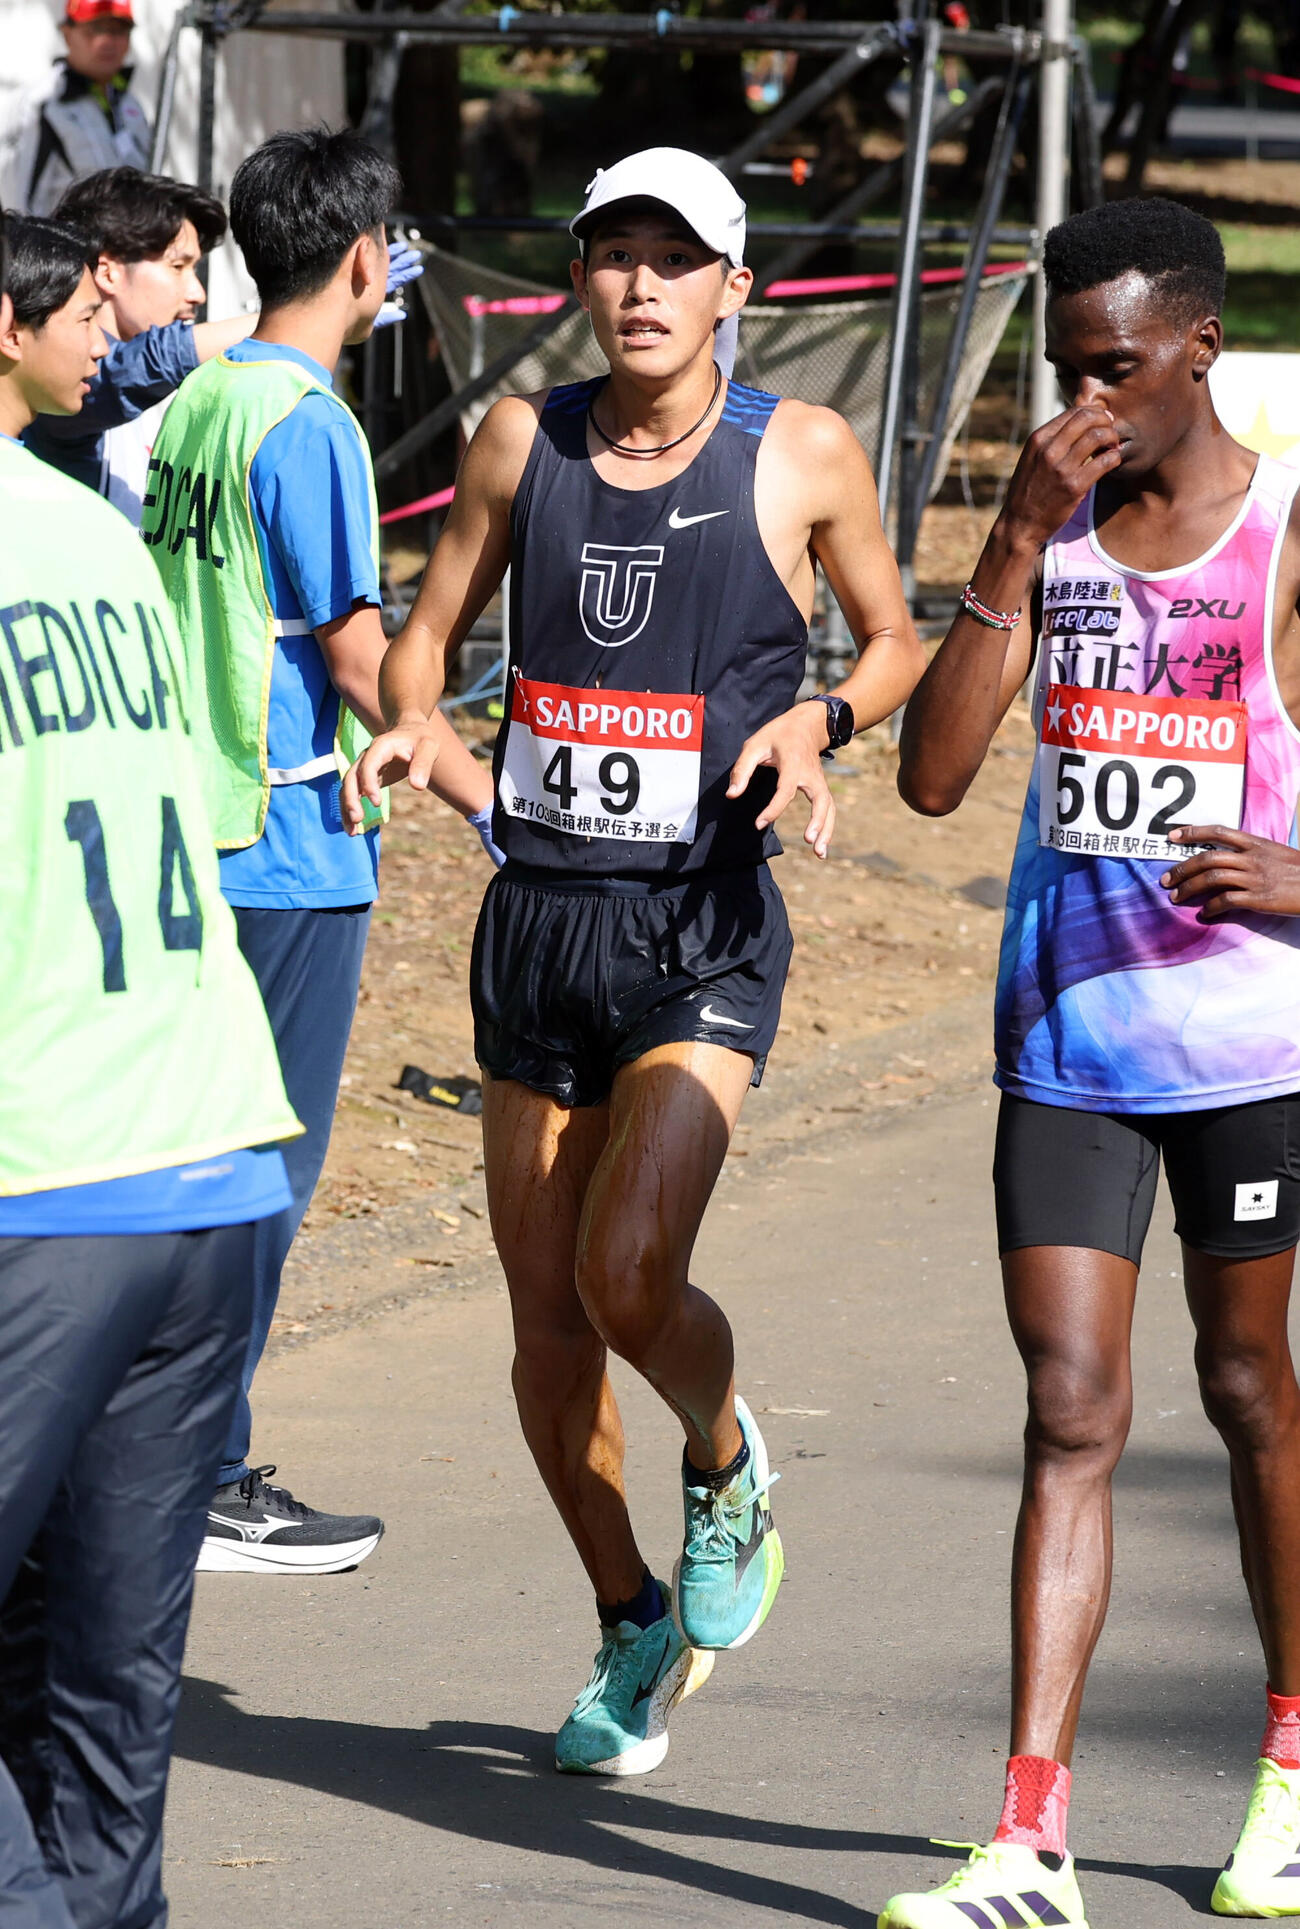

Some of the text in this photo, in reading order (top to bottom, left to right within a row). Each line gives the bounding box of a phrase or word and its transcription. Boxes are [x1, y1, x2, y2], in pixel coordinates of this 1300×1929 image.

[140, 459, 225, 569] EDICAL
[1045, 581, 1111, 601] 木島陸運
[1168, 599, 1246, 620] 2XU
[1049, 637, 1245, 701] 立正大学
[536, 696, 693, 740] SAPPORO
[1068, 702, 1236, 751] SAPPORO
[543, 745, 641, 816] 49
[1056, 752, 1197, 837] 502
[512, 796, 679, 839] 第103回箱根駅伝予選会
[64, 795, 204, 993] 14
